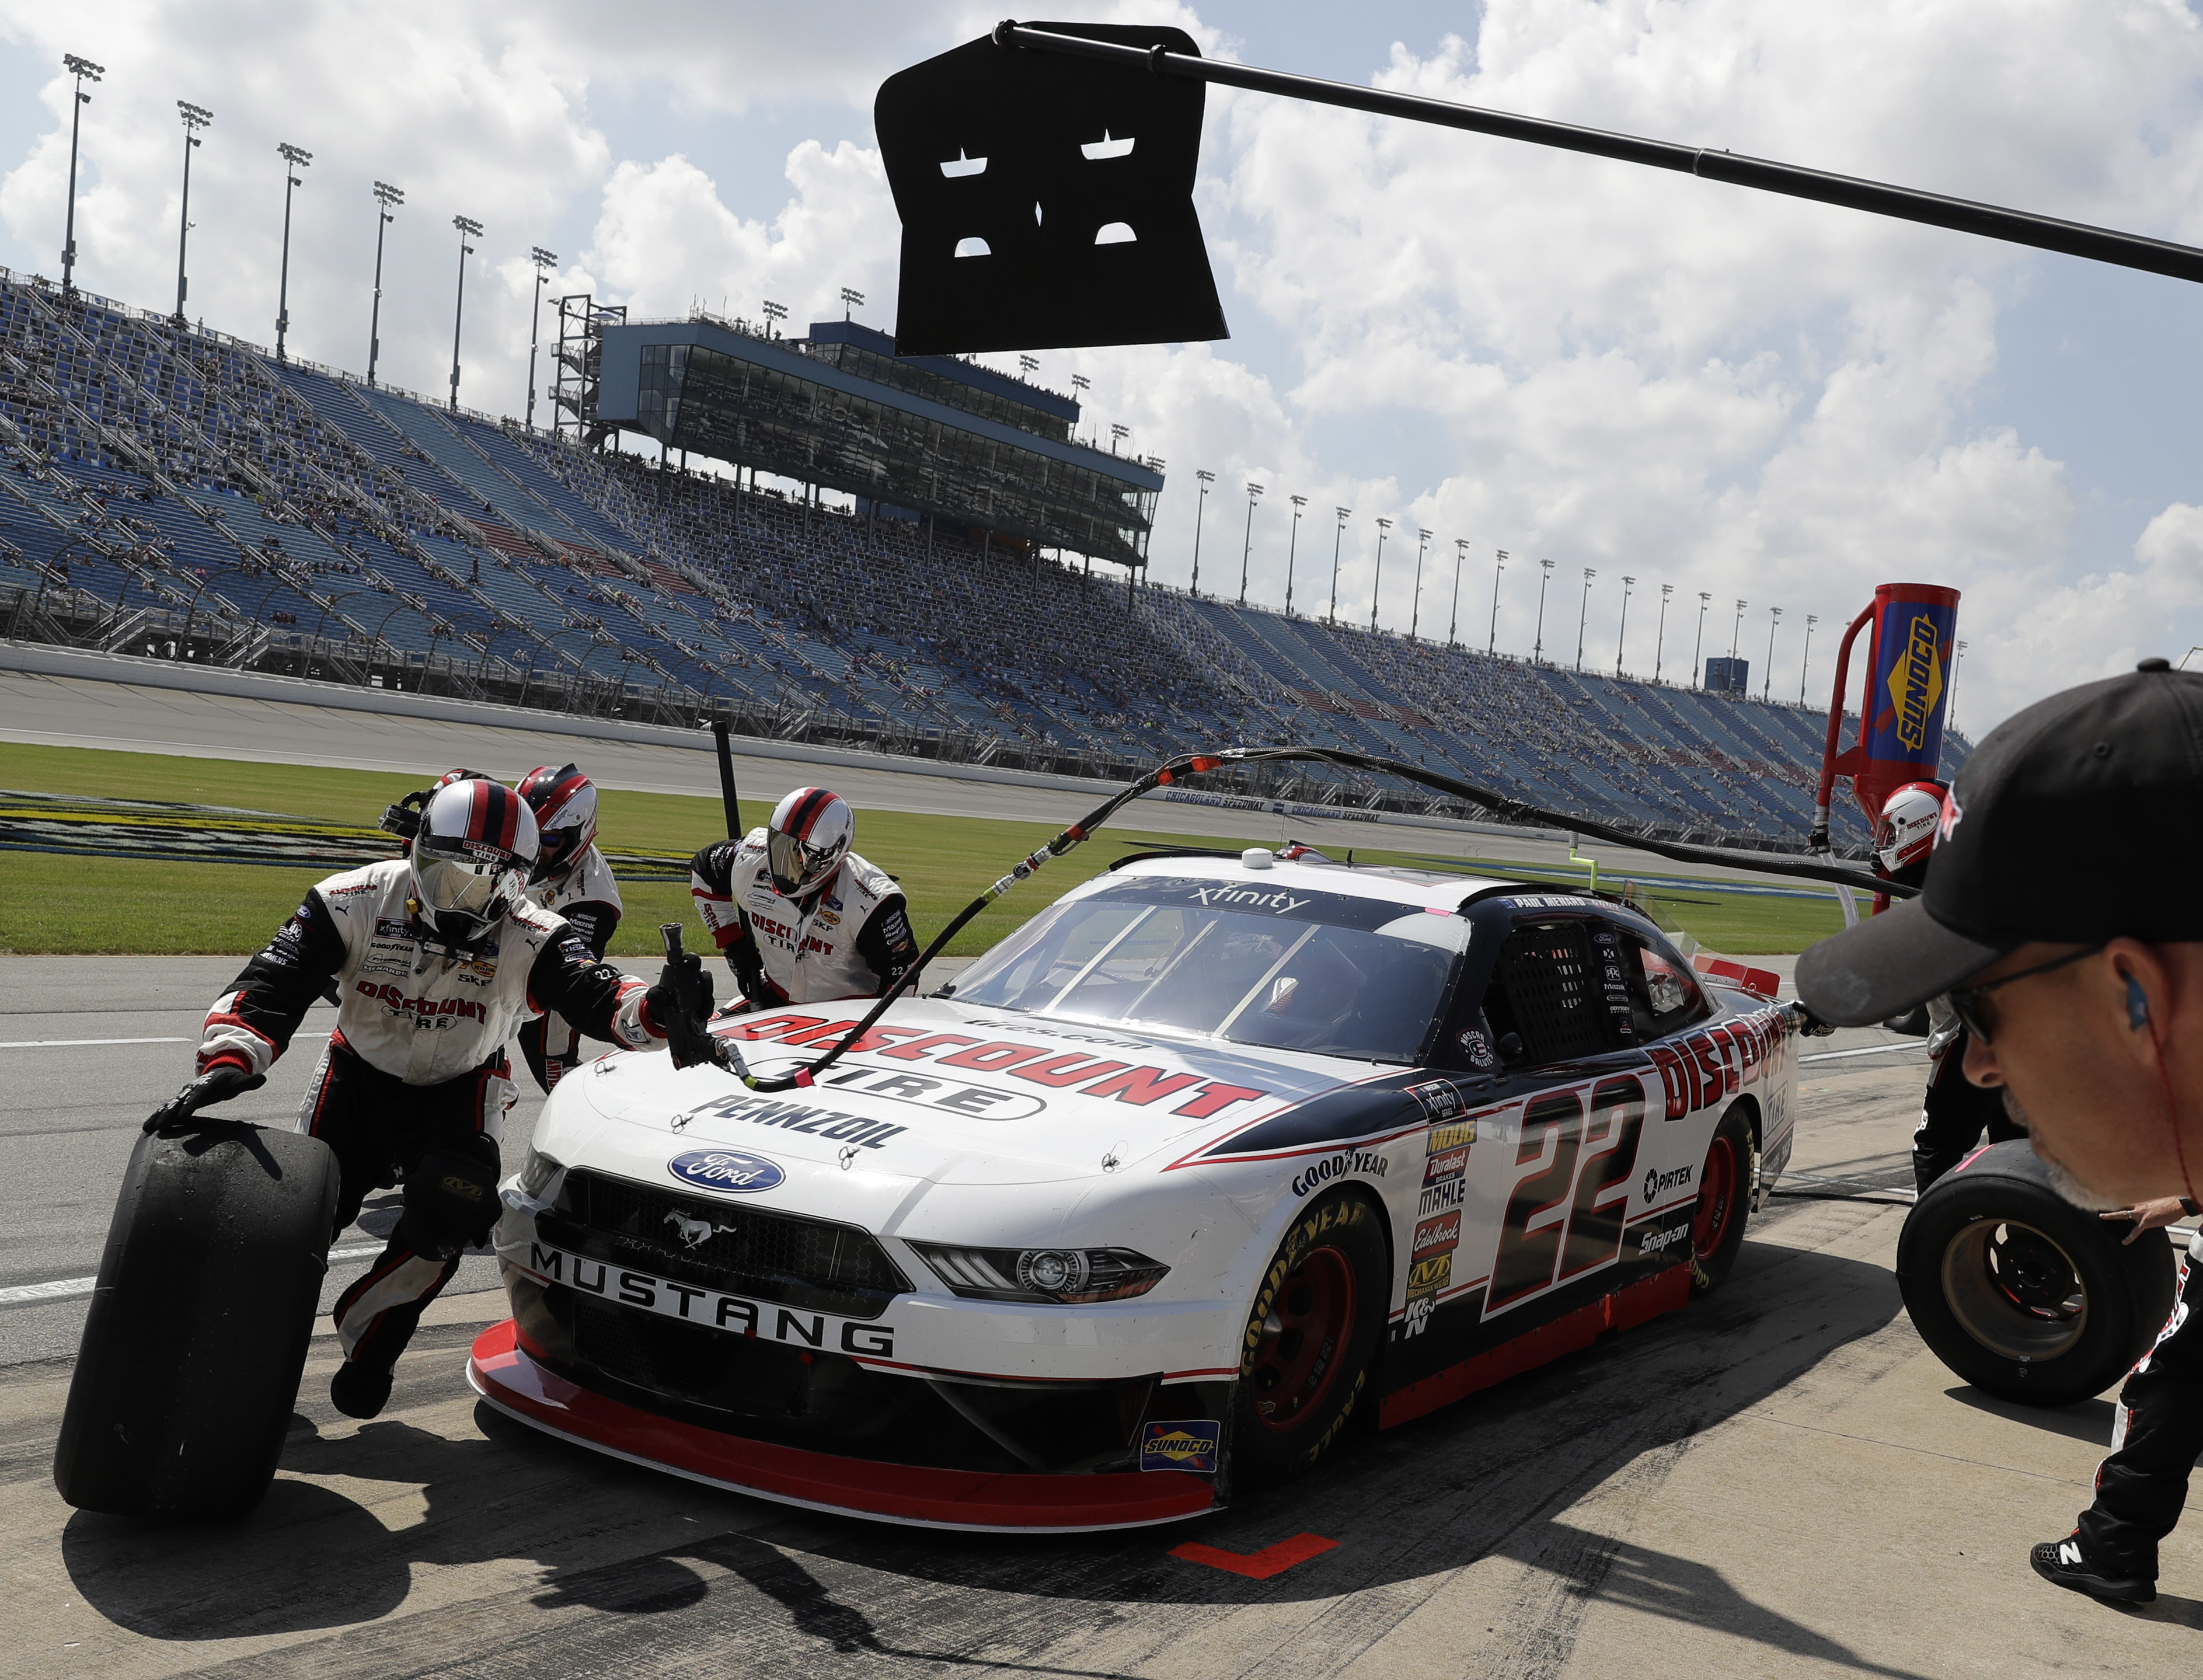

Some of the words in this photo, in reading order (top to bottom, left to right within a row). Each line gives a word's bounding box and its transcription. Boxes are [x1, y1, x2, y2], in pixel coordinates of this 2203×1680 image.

[1901, 619, 1934, 747] SUNOCO
[1165, 790, 1222, 806] CHICAGOLAND
[1223, 797, 1265, 810] SPEEDWAY
[1291, 806, 1341, 818] CHICAGOLAND
[1343, 810, 1380, 823] SPEEDWAY
[1907, 812, 1937, 829] DISCOUNT
[463, 841, 511, 860] DISCOUNT
[476, 851, 496, 861] TIRE
[1188, 887, 1312, 914] xfinity
[1514, 897, 1545, 908] PAUL
[1543, 897, 1586, 907] MENARD
[569, 918, 595, 930] Mazak
[577, 913, 597, 922] NASCAR
[380, 925, 410, 937] xfinity
[751, 912, 834, 956] DISCOUNT
[595, 969, 613, 980] 22
[891, 967, 904, 976] 22
[1606, 967, 1620, 979] PPG
[355, 980, 487, 1025] DISCOUNT
[389, 1009, 449, 1029] TIRE
[963, 1019, 1153, 1050] tires.com
[1460, 1030, 1484, 1047] NASCAR
[712, 1014, 1271, 1119] DISCOUNT
[1470, 1052, 1494, 1067] SALUTES
[1646, 1005, 1787, 1122] DISCOUNT
[774, 1060, 1015, 1113] TIRE
[1425, 1090, 1456, 1114] xfinity
[1768, 1087, 1787, 1132] TIRE
[688, 1095, 909, 1149] PENNZOIL
[1428, 1120, 1476, 1153] MOOG
[686, 1153, 765, 1186] Ford
[1291, 1146, 1389, 1198] GOODYEAR
[1430, 1150, 1466, 1176] Duralast
[1435, 1172, 1455, 1184] BRAKES
[1657, 1165, 1694, 1194] PIRTEK
[1417, 1179, 1466, 1217] MAHLE
[1484, 1073, 1646, 1316] 22
[1414, 1219, 1459, 1253] Edelbrock
[1638, 1223, 1689, 1256] Snap-on
[530, 1242, 895, 1358] MUSTANG
[1240, 1201, 1365, 1377] GOODYEAR
[1407, 1284, 1434, 1300] MECHANIX
[1434, 1275, 1449, 1291] WEAR
[1307, 1369, 1366, 1465] EAGLE
[1146, 1439, 1212, 1453] SUNOCO
[2059, 1541, 2083, 1566] N
